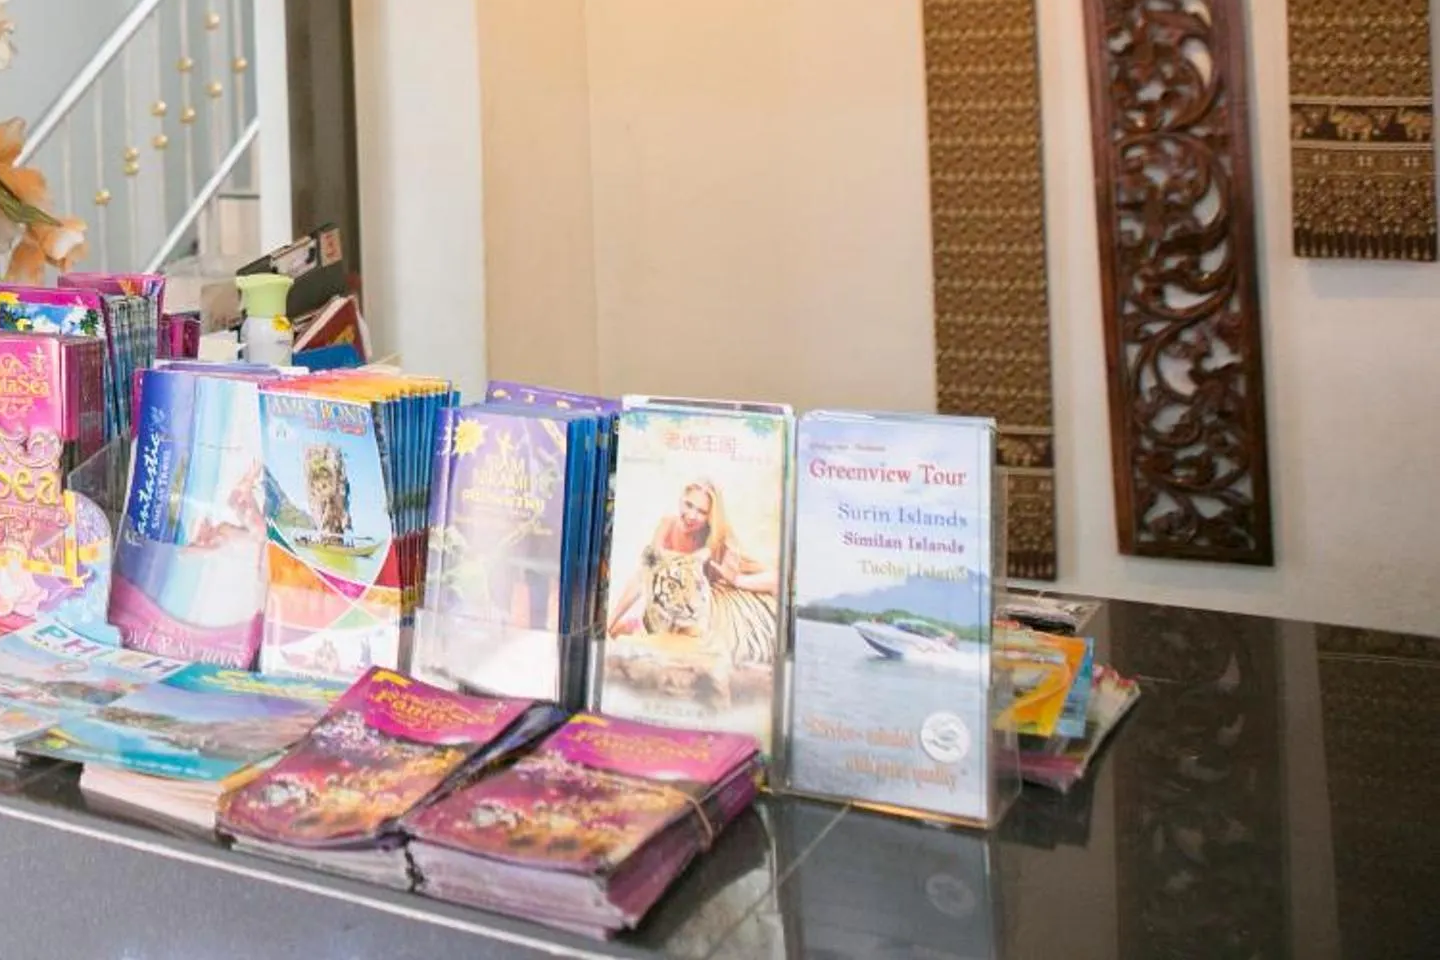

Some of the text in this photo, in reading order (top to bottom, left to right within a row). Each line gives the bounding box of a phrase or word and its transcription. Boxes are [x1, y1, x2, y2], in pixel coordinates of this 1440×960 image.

[810, 457, 968, 486] Greenview Tour
[837, 502, 969, 528] Surin Islands
[843, 530, 965, 554] Similan Islands
